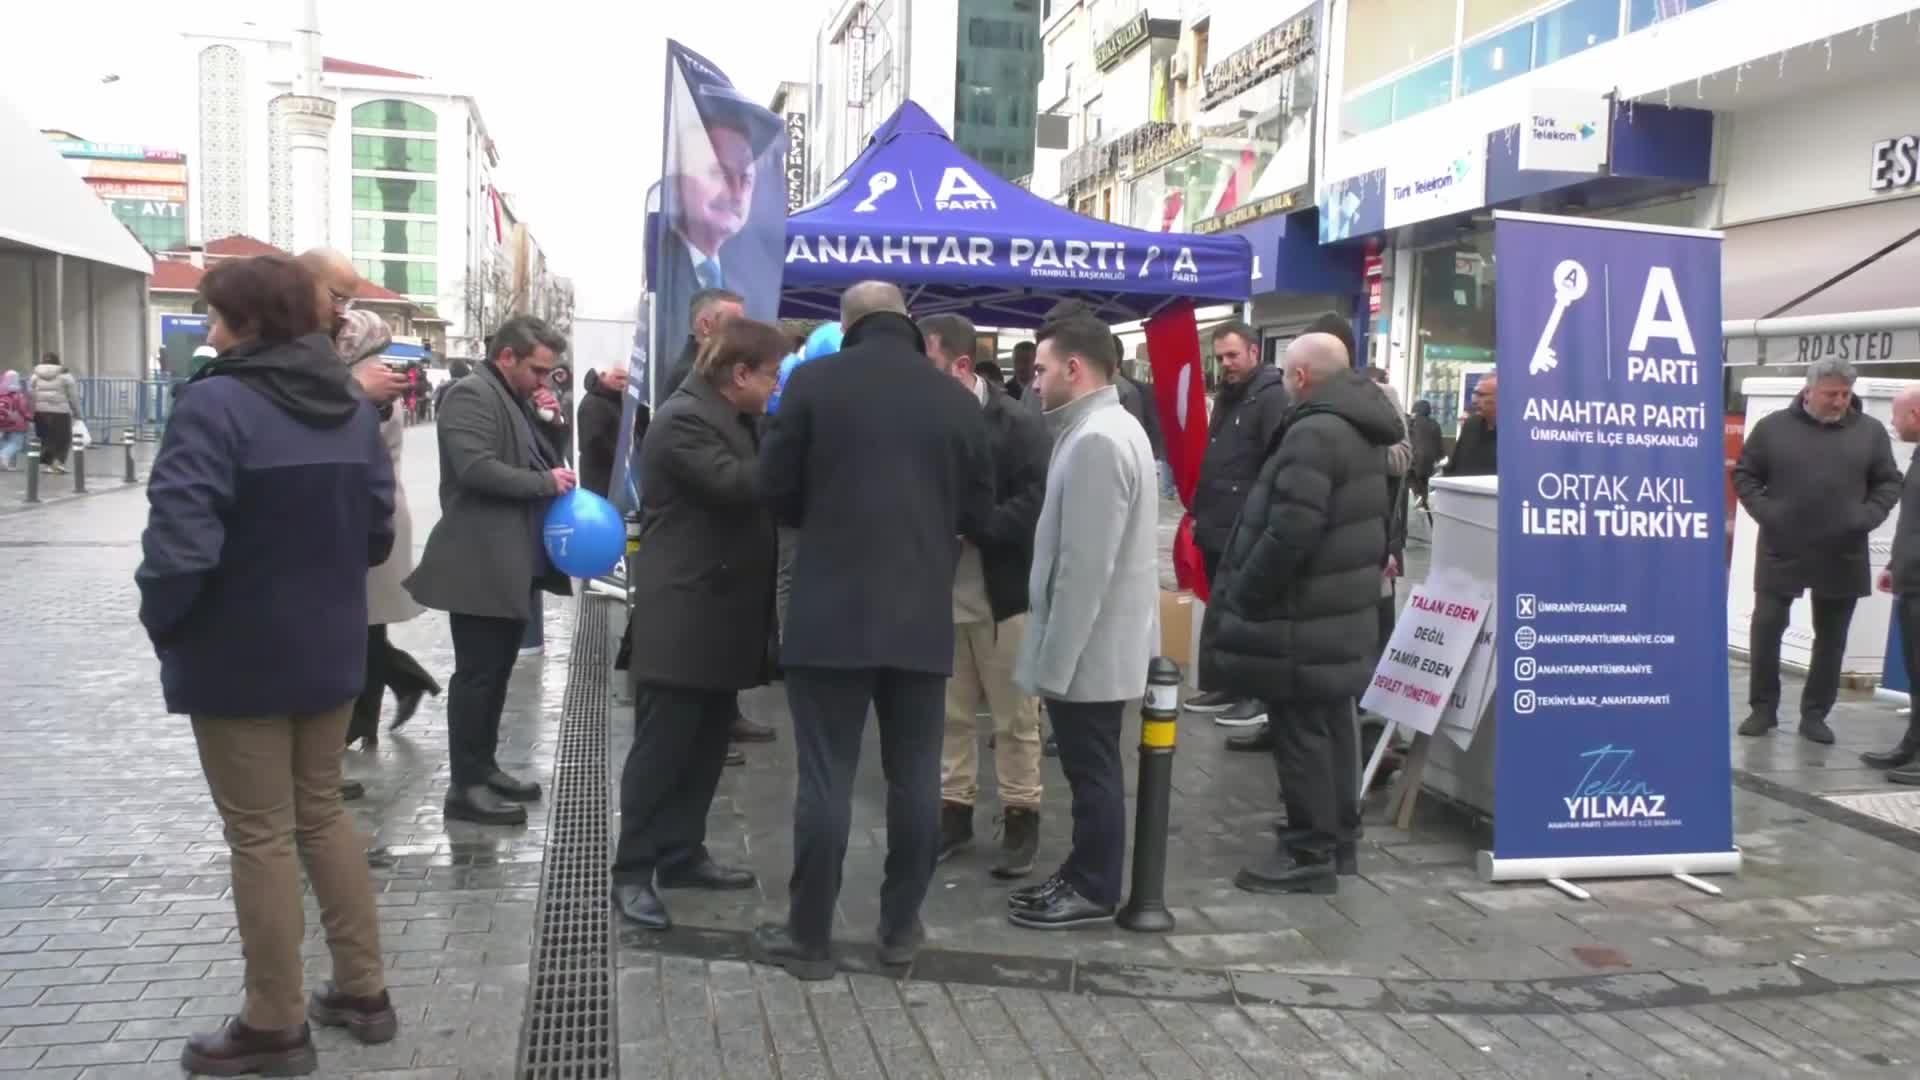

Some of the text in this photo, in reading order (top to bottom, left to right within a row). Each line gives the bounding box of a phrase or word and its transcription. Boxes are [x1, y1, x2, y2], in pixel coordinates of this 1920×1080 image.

[1532, 116, 1555, 127] Türk
[1532, 129, 1576, 141] Telekom
[1872, 136, 1920, 189] ES
[935, 167, 993, 200] A
[1393, 174, 1453, 200] Türk Telekom
[142, 202, 180, 216] AYT
[785, 234, 996, 266] ANAHTAR
[1173, 247, 1198, 272] A
[1031, 268, 1069, 278] İSTANBUL
[1079, 269, 1125, 281] BAŞKANLIĞI
[1627, 266, 1696, 355] A
[1797, 332, 1893, 362] ROASTED
[1522, 397, 1636, 427] ANAHTAR
[1643, 402, 1705, 430] PARTİ
[1531, 427, 1698, 448] ÜMRANİYE İLÇE BAŞKANLIĞI
[1538, 472, 1693, 504] ORTAK AKIL
[1522, 500, 1709, 539] İLERİ TÜRKİYE
[1411, 595, 1479, 622] TALAN EDEN
[1538, 601, 1627, 613] ÜMRANİYEANAHTAR
[1388, 648, 1453, 679] TAMİR EDEN
[1374, 675, 1402, 693] DEVLET
[1564, 795, 1666, 819] YILMAZ
